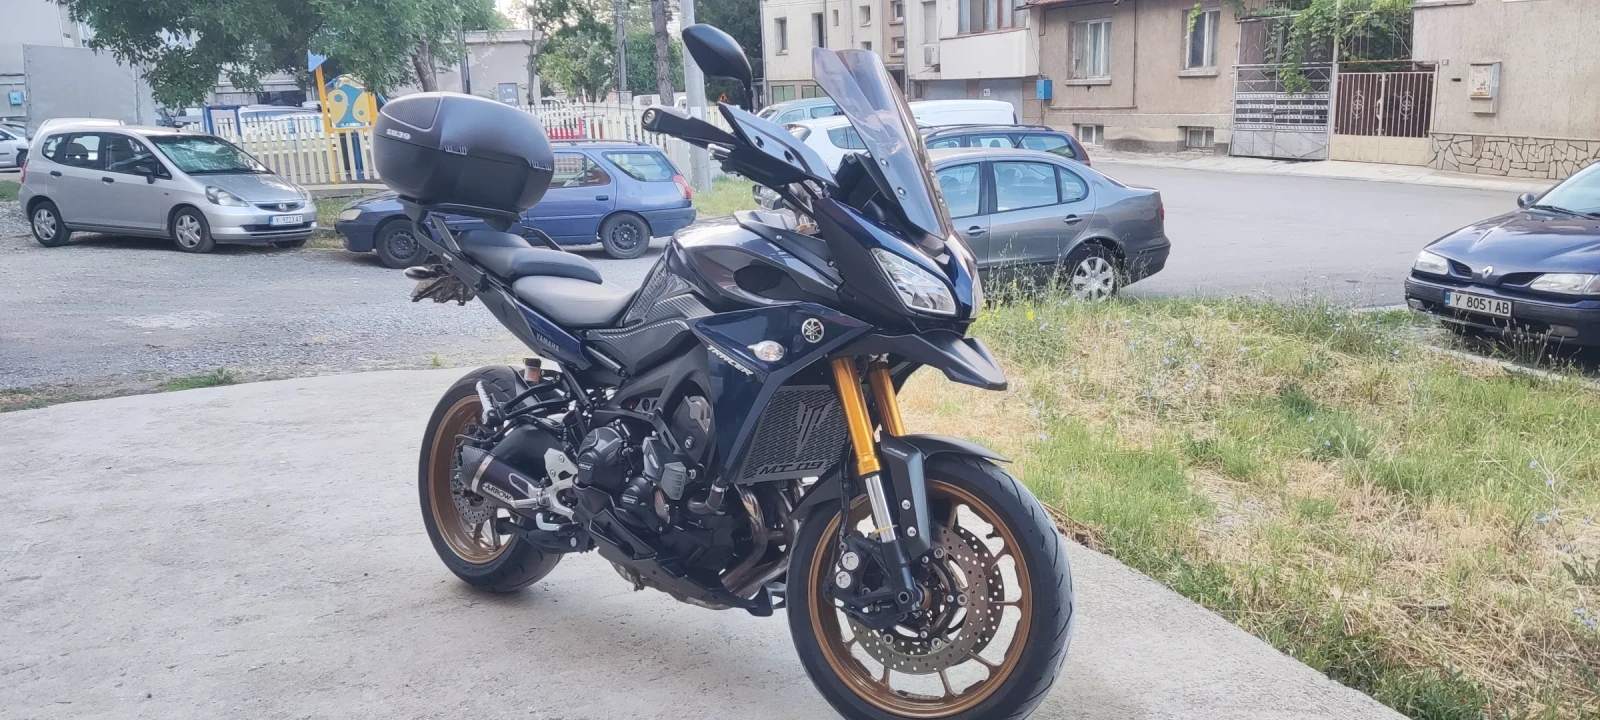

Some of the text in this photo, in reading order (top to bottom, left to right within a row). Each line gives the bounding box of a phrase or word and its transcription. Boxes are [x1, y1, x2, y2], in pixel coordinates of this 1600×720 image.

[1455, 294, 1510, 315] Y 8051 AB
[536, 331, 560, 354] YAMAHA
[707, 344, 755, 377] TRACER
[482, 483, 513, 501] ARROW
